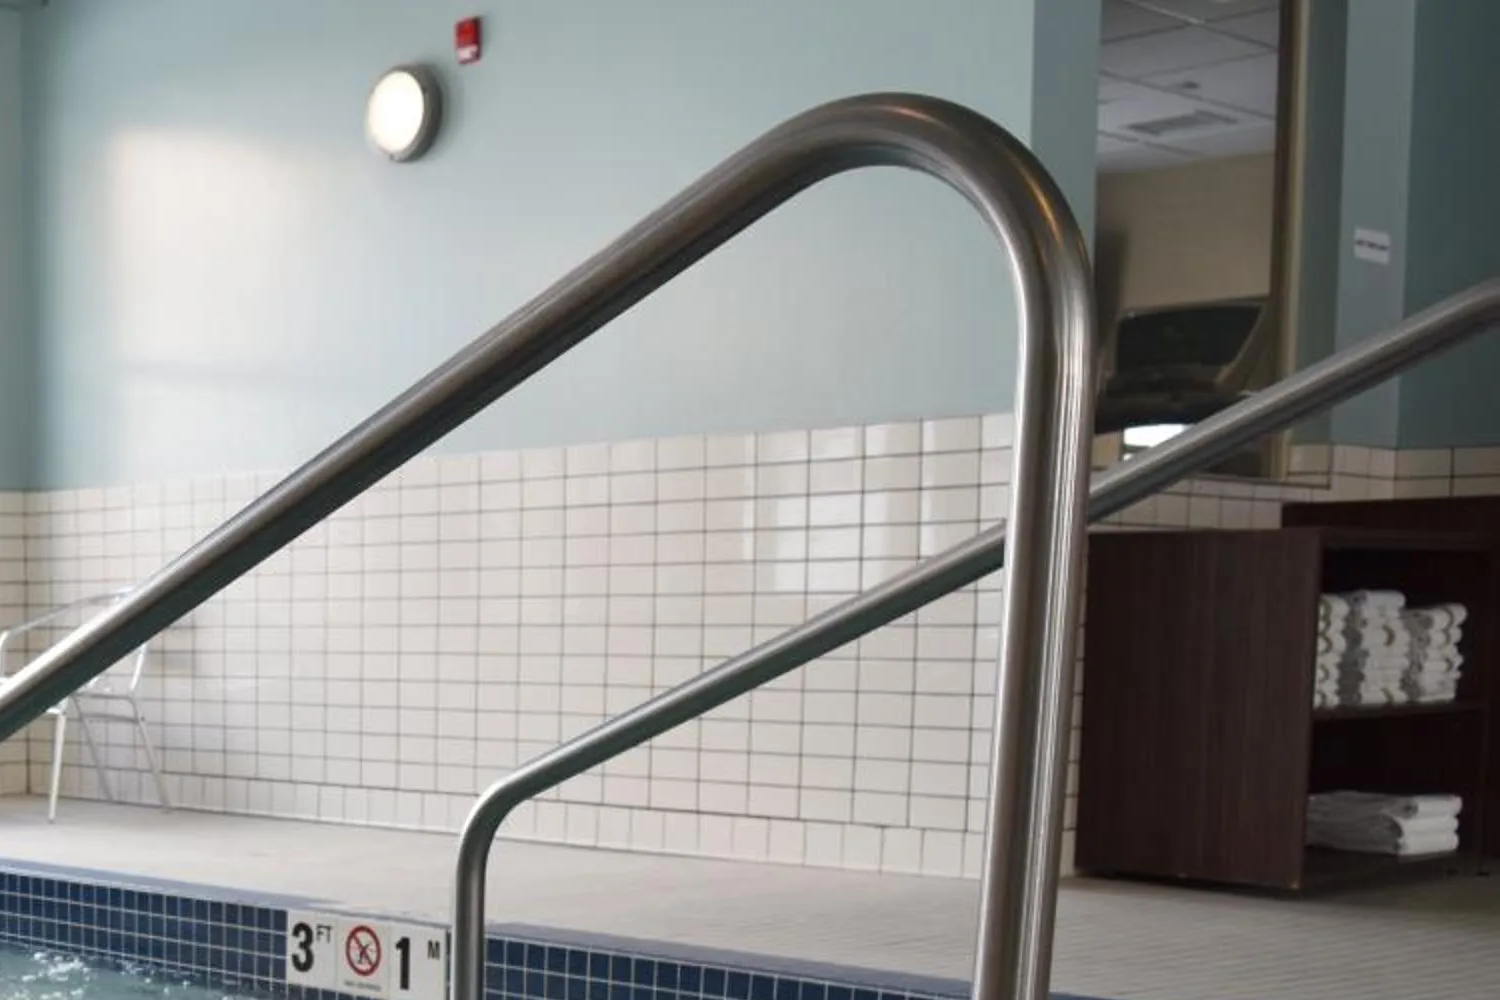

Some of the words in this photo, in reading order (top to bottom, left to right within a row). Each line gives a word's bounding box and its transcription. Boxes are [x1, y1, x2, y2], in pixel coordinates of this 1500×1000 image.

[292, 922, 315, 972] 3
[316, 924, 332, 943] FT
[395, 937, 410, 990] 1
[427, 940, 440, 960] M
